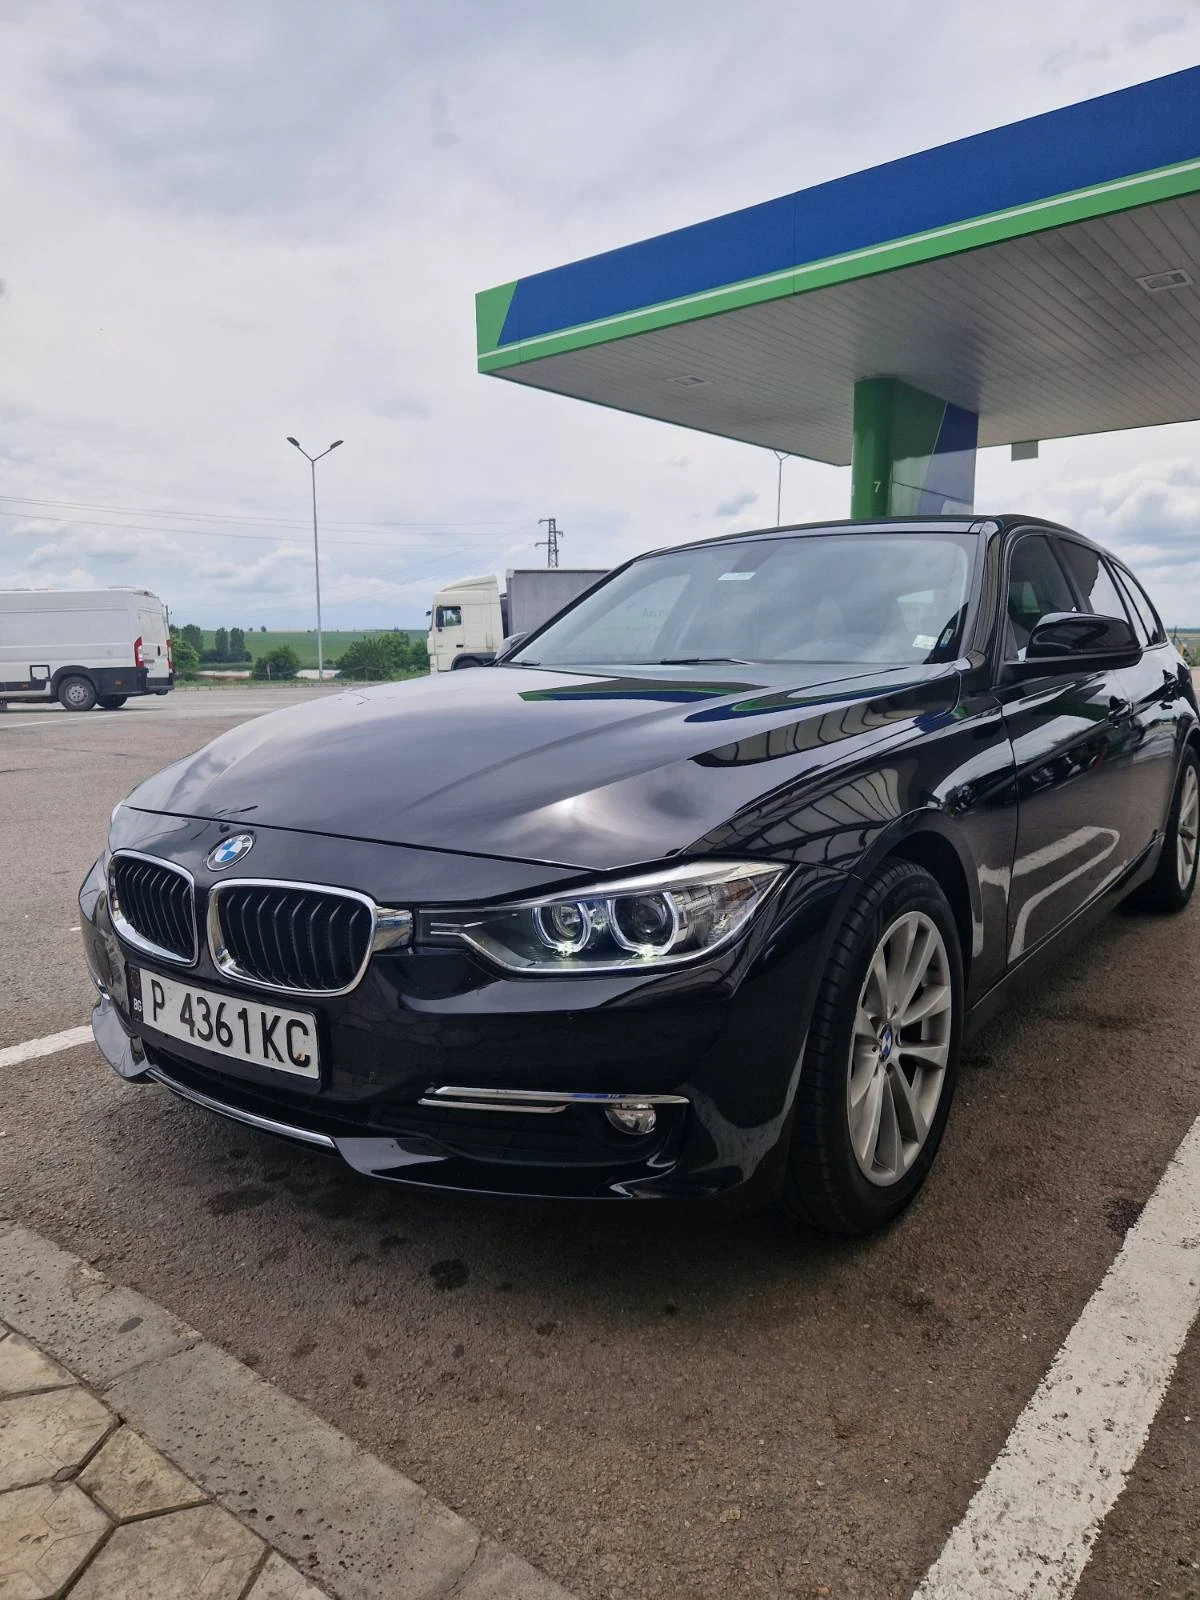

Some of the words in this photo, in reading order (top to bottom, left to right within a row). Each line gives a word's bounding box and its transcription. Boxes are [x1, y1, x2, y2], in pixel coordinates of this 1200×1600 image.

[873, 480, 882, 493] 7
[133, 997, 143, 1012] BG
[150, 979, 165, 1022] P
